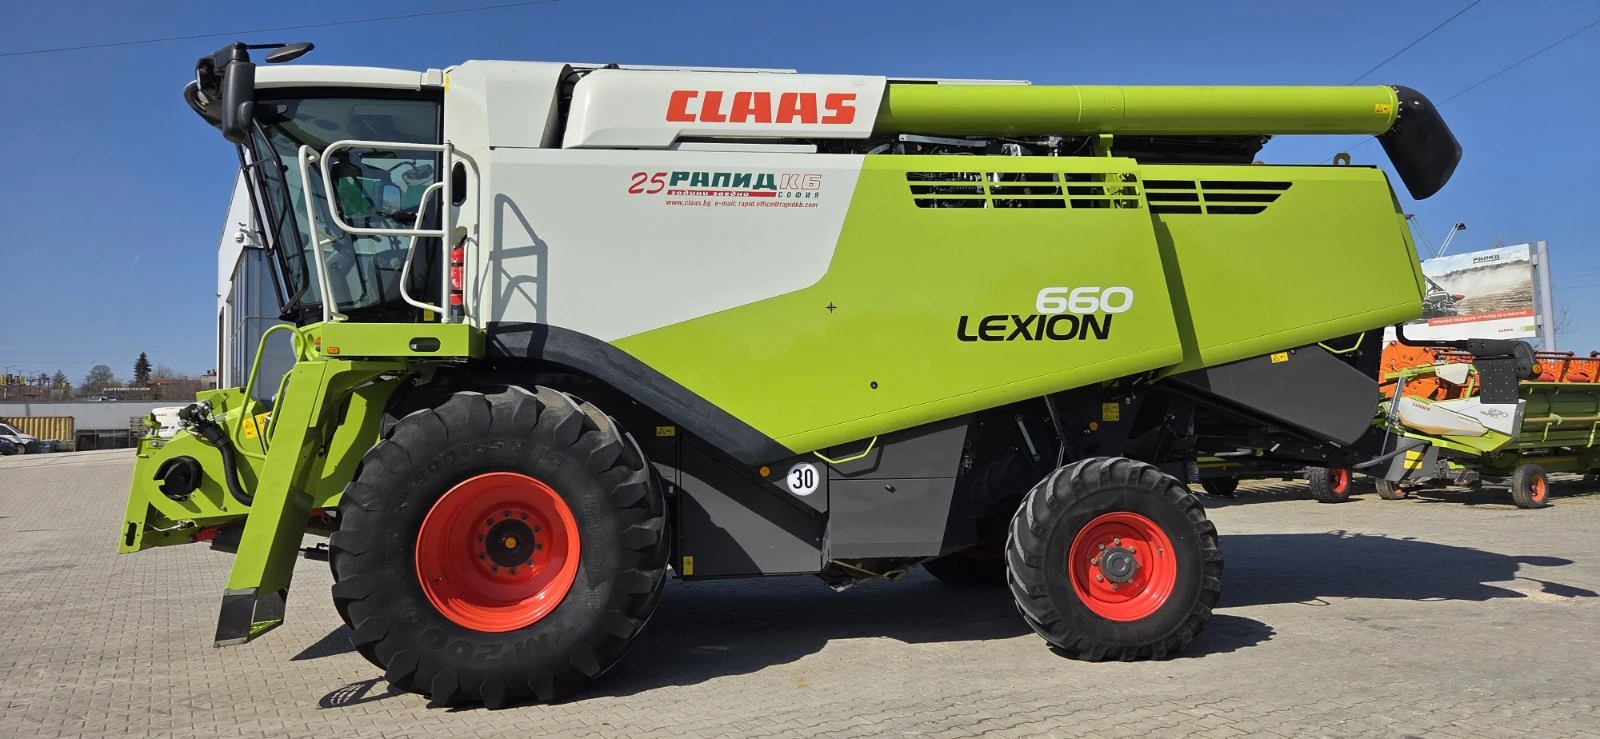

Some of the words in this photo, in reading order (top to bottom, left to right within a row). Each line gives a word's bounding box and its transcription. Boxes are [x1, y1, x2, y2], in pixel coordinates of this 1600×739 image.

[665, 90, 857, 125] CLAAS
[627, 171, 668, 195] 25
[669, 171, 777, 190] РАПИД
[779, 173, 822, 191] КБ
[665, 199, 712, 208] www.claas.bg
[738, 200, 818, 209] rapid.office@rapidkb.com
[1035, 286, 1134, 314] 660
[957, 314, 1113, 342] LEXION
[793, 469, 813, 489] 30
